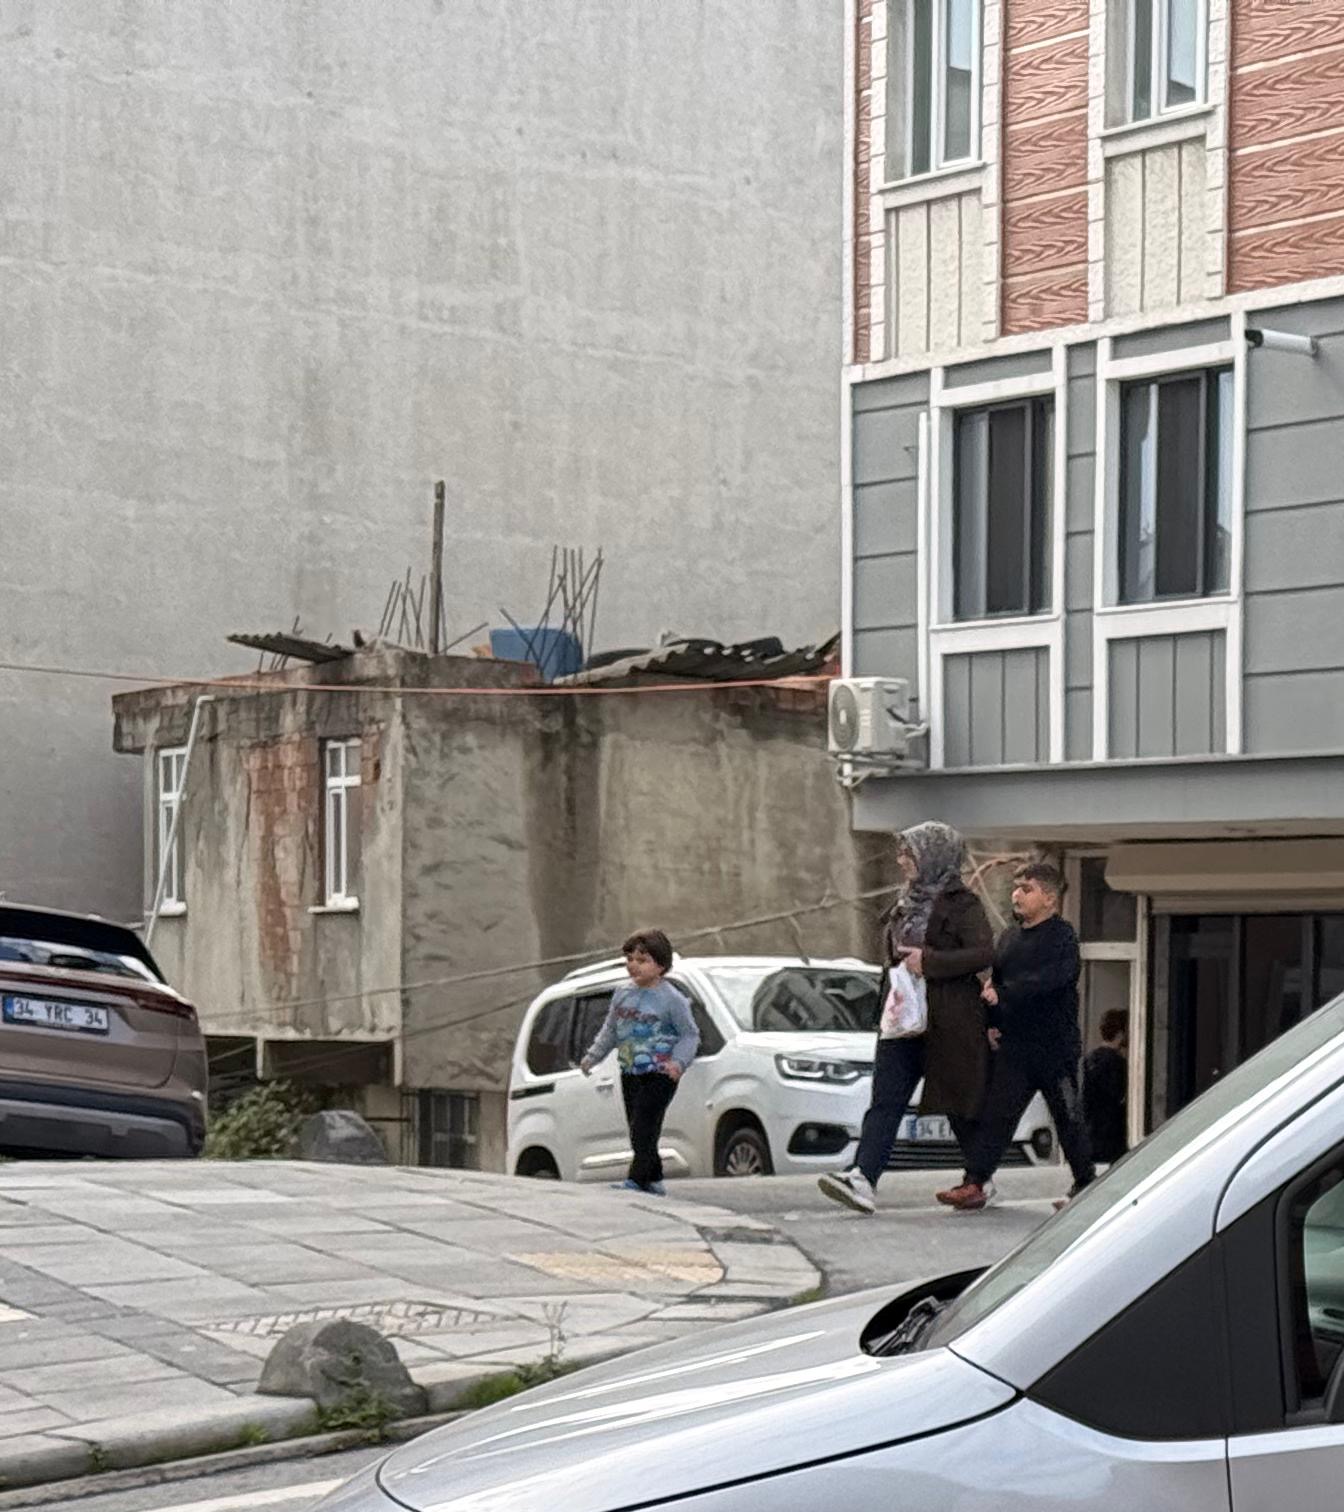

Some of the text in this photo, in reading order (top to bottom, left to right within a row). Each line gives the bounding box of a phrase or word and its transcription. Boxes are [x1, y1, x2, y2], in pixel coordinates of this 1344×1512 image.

[15, 1000, 103, 1025] 34 YRC 34
[919, 1121, 933, 1136] 34
